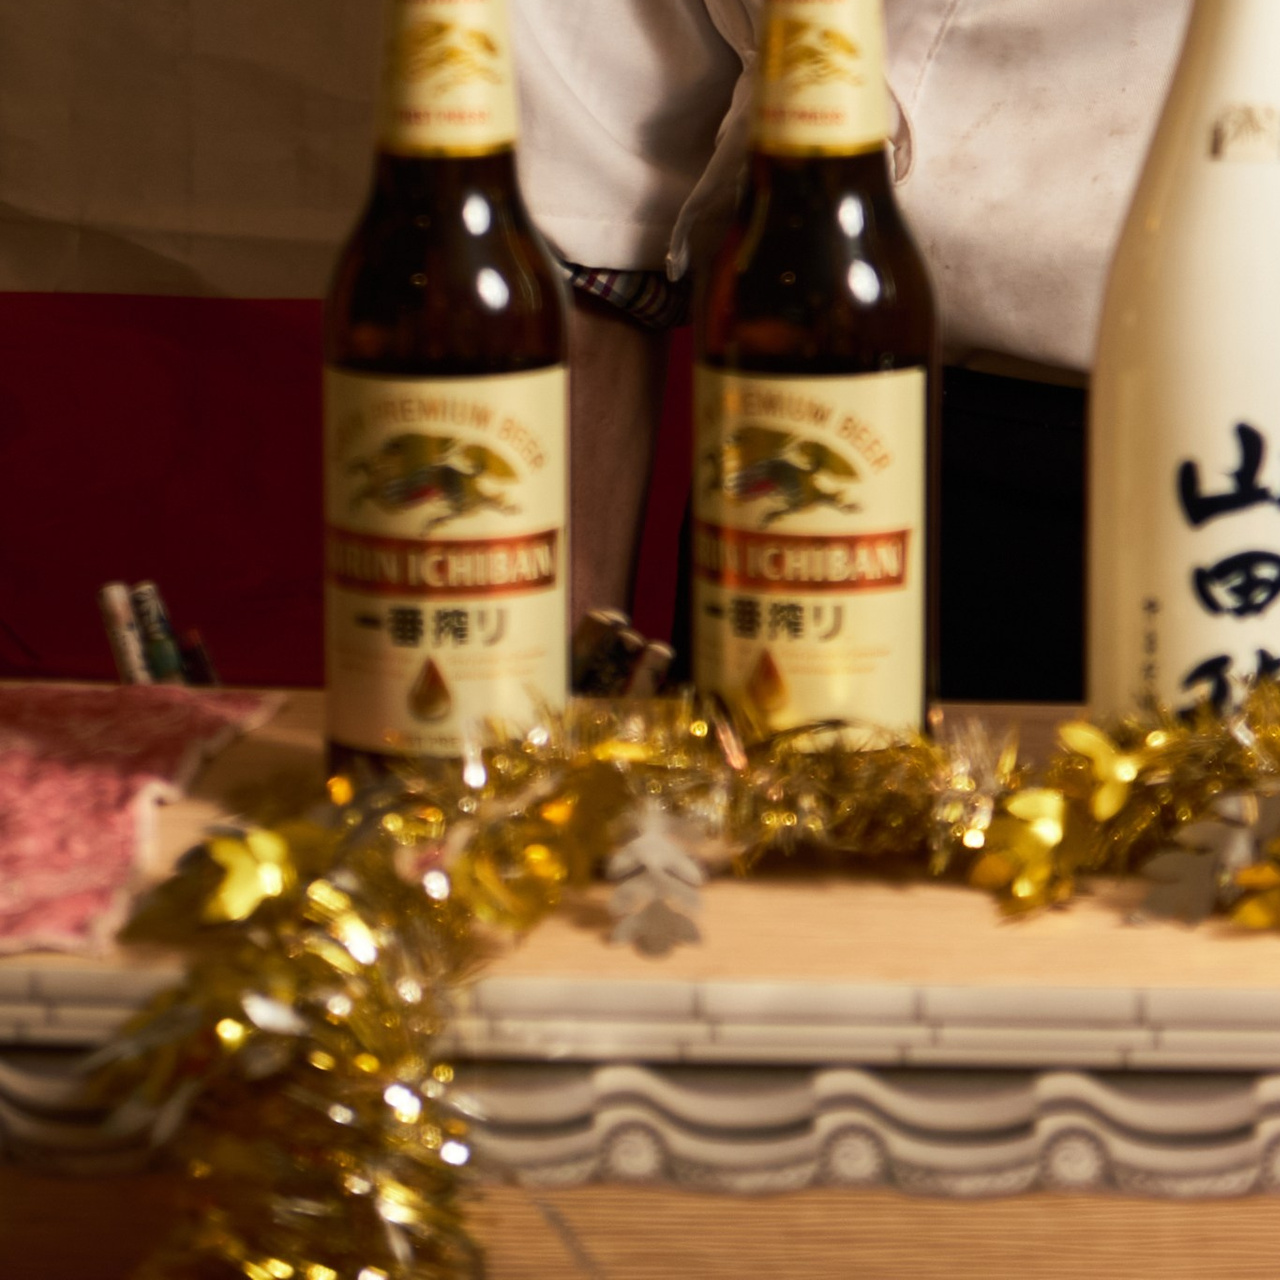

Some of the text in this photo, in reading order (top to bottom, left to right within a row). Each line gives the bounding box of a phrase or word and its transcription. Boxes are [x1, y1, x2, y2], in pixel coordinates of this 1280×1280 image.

[498, 414, 547, 475] BEER
[406, 542, 554, 589] ICHIBAN
[745, 541, 902, 583] ICHIBAN
